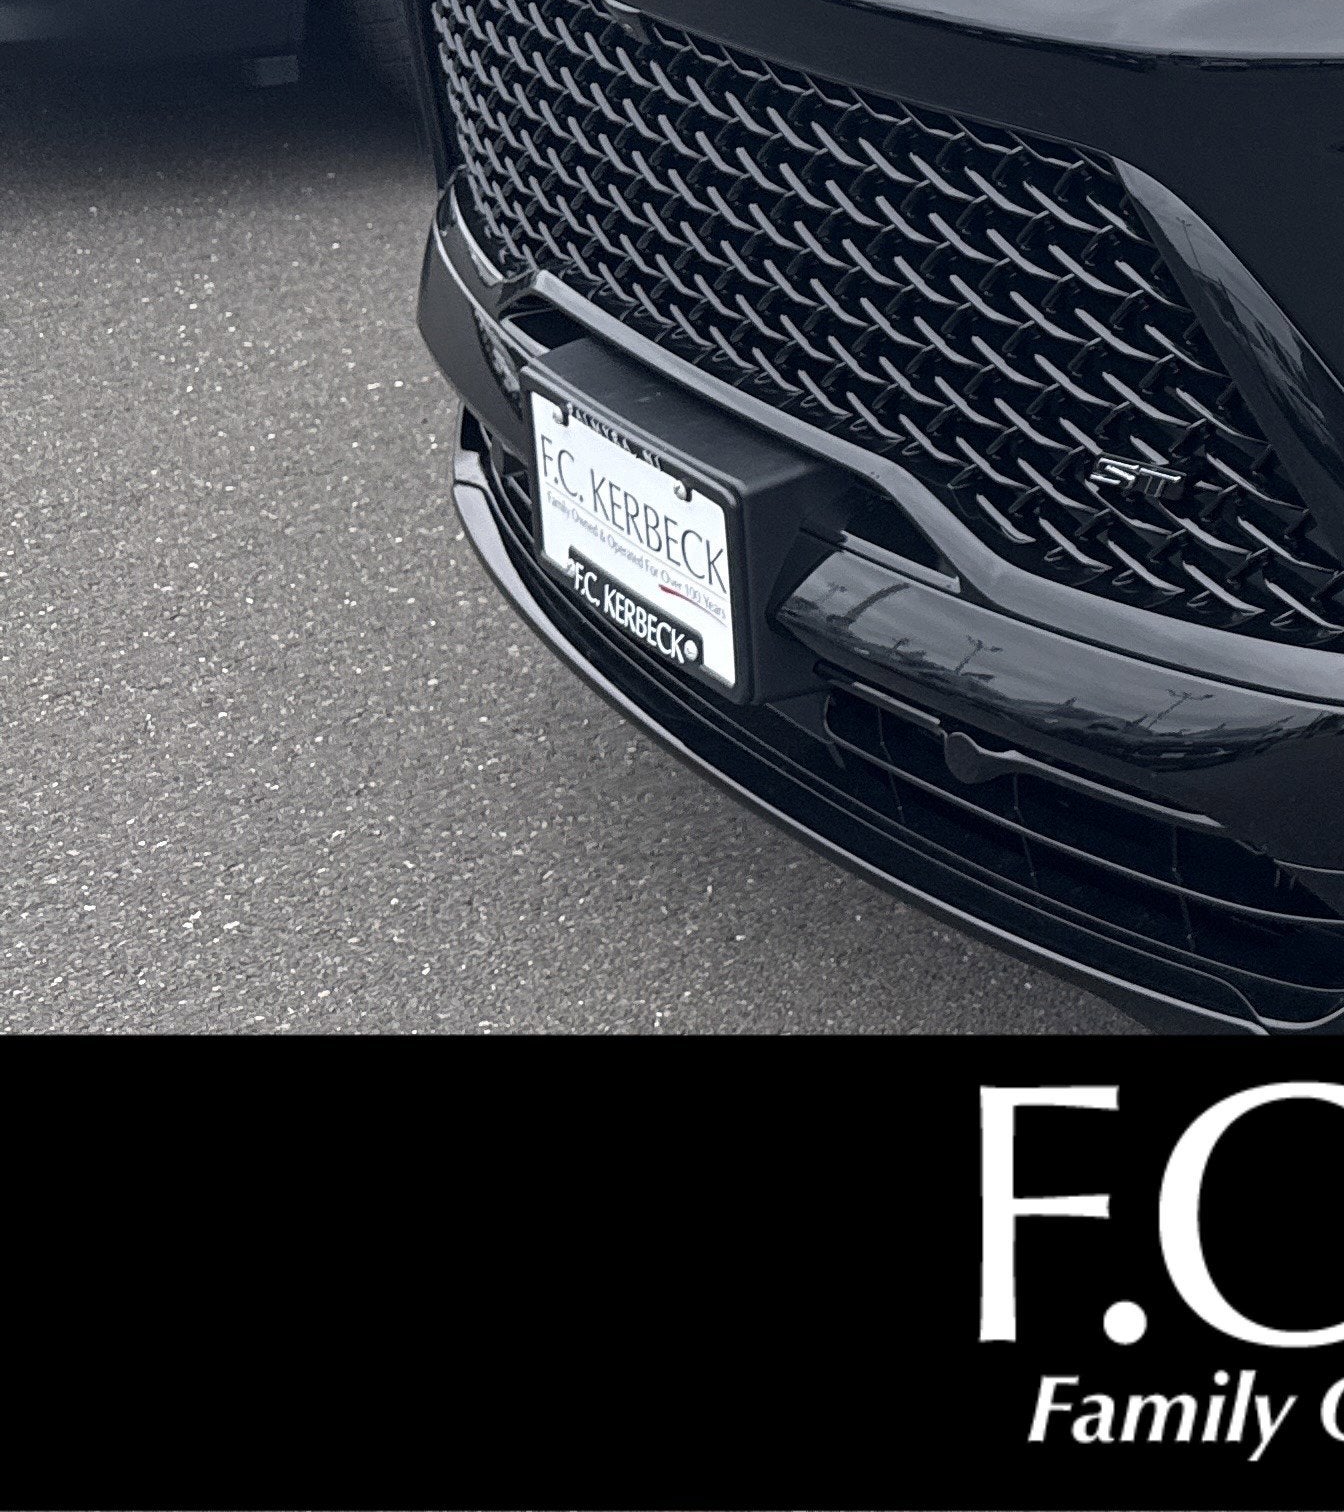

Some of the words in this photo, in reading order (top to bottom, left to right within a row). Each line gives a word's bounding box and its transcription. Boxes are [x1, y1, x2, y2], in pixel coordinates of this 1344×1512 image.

[540, 432, 586, 504] F.C.
[590, 468, 727, 594] KERBECK
[574, 561, 601, 608] F.C.
[603, 583, 686, 664] KERBECK
